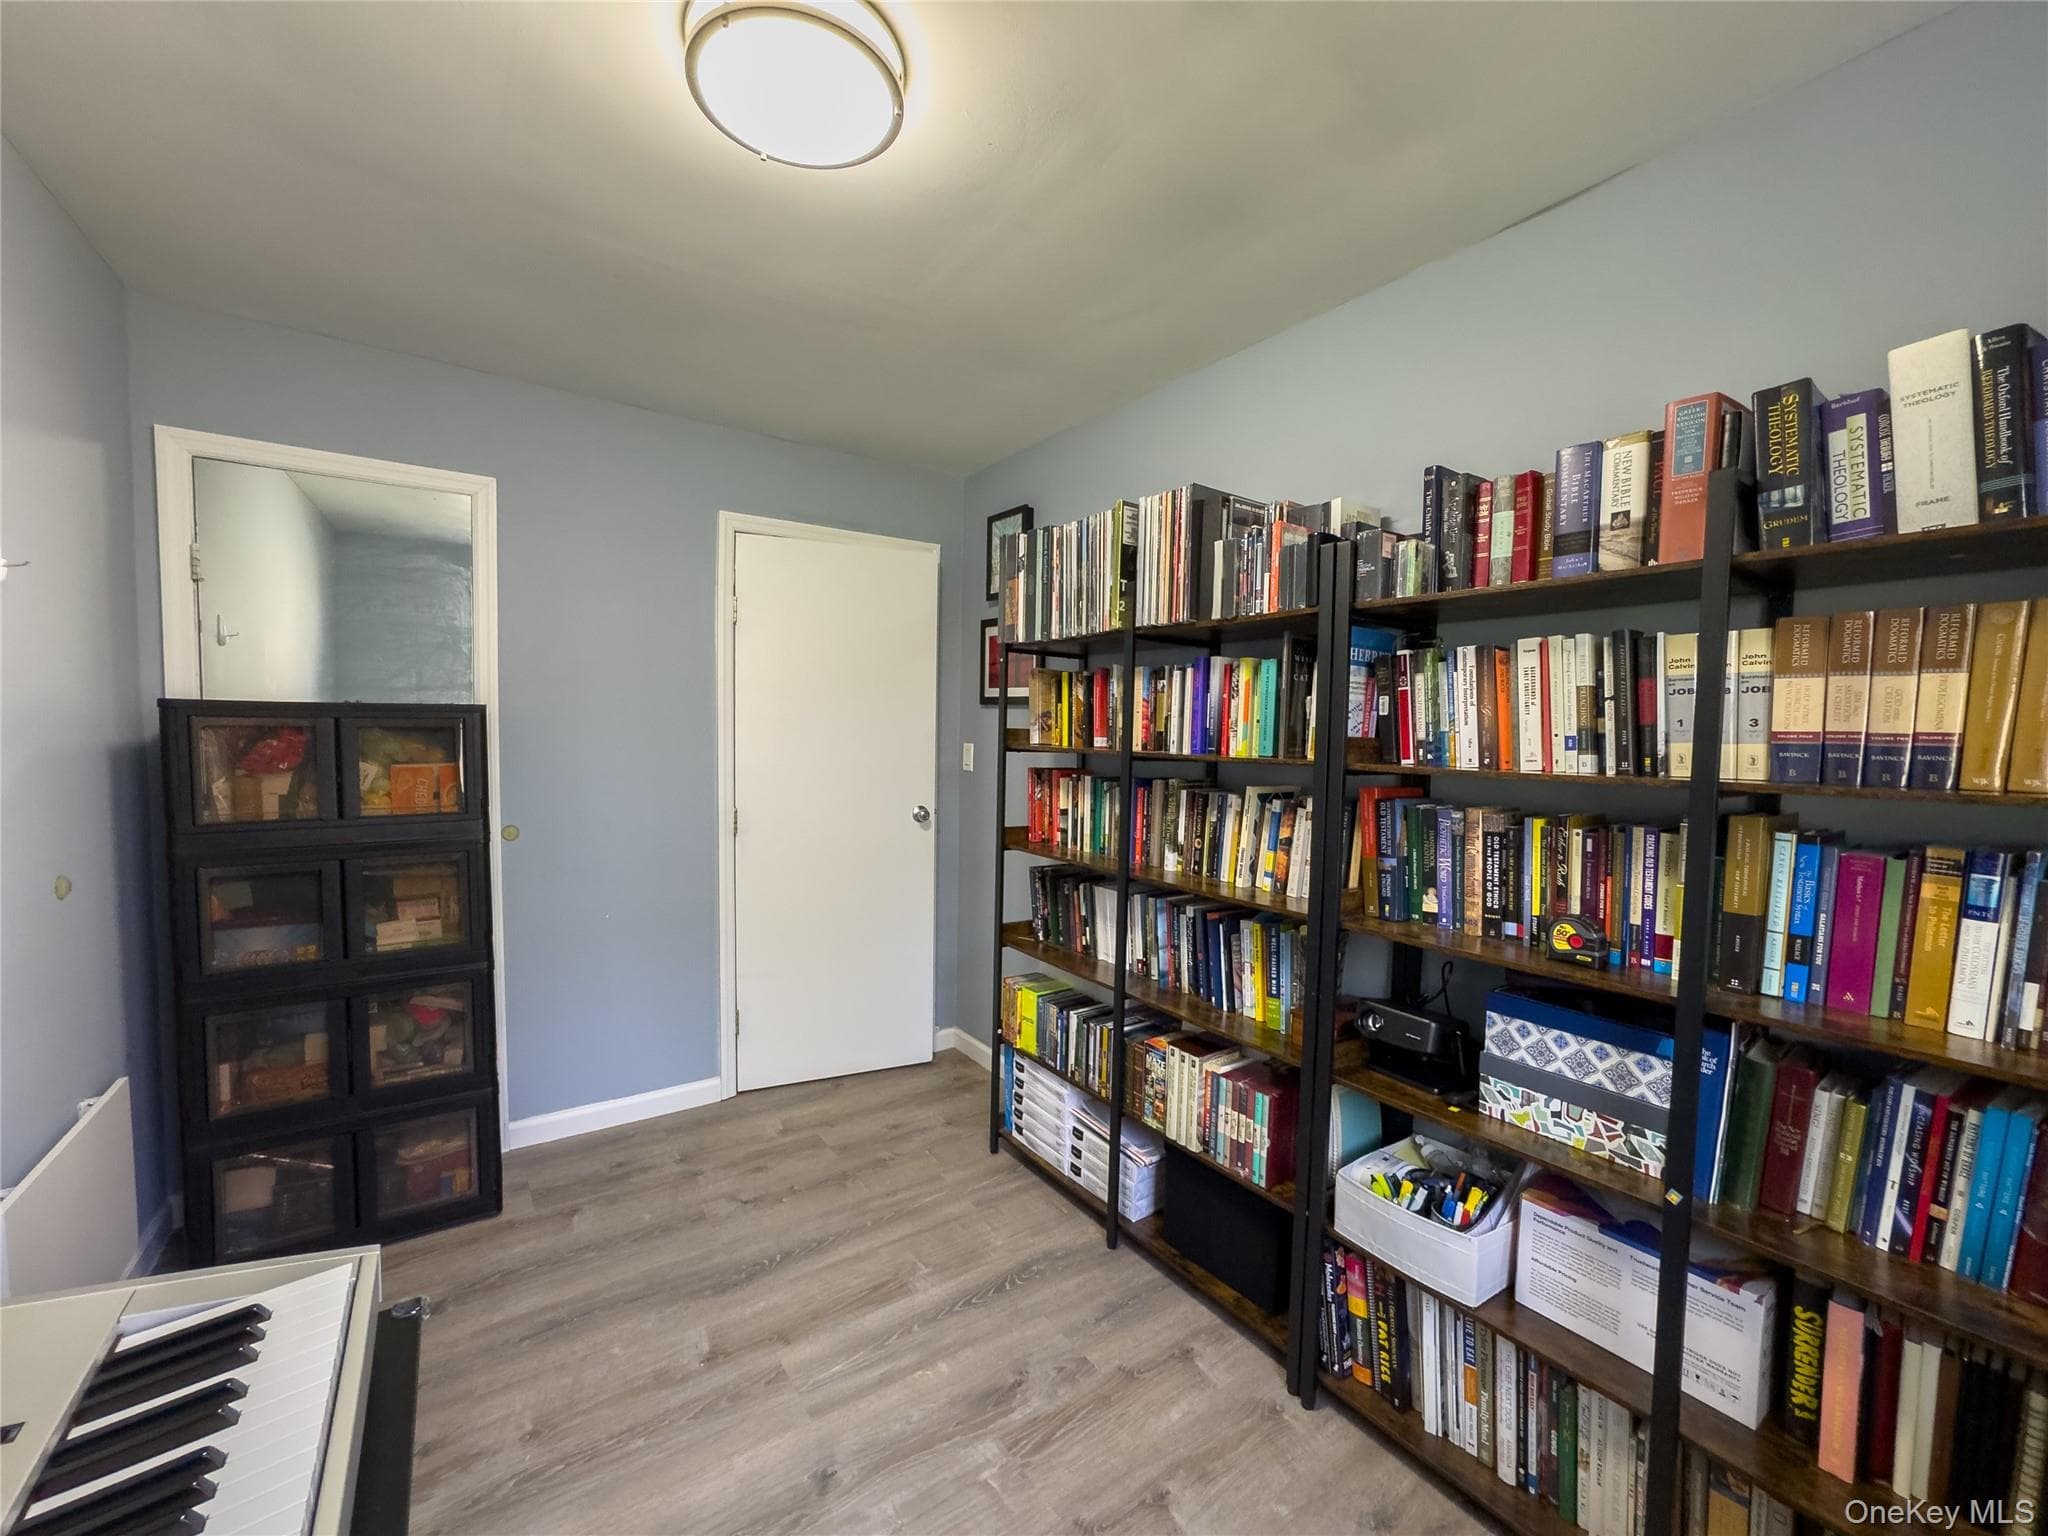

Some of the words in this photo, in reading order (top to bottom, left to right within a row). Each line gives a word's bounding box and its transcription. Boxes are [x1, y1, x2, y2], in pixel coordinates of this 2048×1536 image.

[1997, 365, 2010, 382] The
[1901, 382, 1960, 402] SYSTEMATIC
[1903, 391, 1957, 408] THEOLOGY
[1982, 369, 1994, 420] REFORMED
[1997, 383, 2011, 412] Oxford
[1768, 403, 1783, 475] THEOLOGY
[1783, 392, 1799, 476] SYSTEMATIC
[1983, 420, 1996, 468] THEOLOGY
[1998, 412, 2013, 453] Handbook
[1583, 450, 1592, 467] THE
[1622, 450, 1632, 473] NEW
[1849, 425, 1867, 518] SYSTEMATIC
[1997, 455, 2013, 465] of
[1559, 455, 1571, 526] COMMENTARY
[1571, 473, 1581, 504] BIBLE
[1607, 452, 1621, 508] COMMENTARY
[1620, 474, 1631, 507] BIBLE
[1832, 449, 1848, 521] THEOLOGY
[1915, 497, 1950, 508] FRAME
[1543, 512, 1551, 532] Study
[1763, 514, 1808, 530] GRUDEM
[1543, 534, 1551, 550] Bible
[1791, 624, 1802, 667] DOGMATICS
[1800, 624, 1811, 666] REFORMED
[1842, 619, 1852, 664] DOGMATICS
[1851, 619, 1863, 663] REFORMED
[1887, 618, 1899, 664] DOGMATICS
[1897, 618, 1910, 663] REFORMED
[1935, 613, 1949, 660] DOGMATICS
[1947, 613, 1961, 659] REFORMED
[1668, 687, 1696, 696] JOB
[1741, 685, 1771, 694] JOB
[1579, 686, 1588, 726] PREACHING
[1883, 686, 1893, 724] CREATION
[1934, 675, 1948, 731] PROLEGOMENA
[1677, 719, 1684, 727] 1
[1748, 718, 1760, 728] 3
[1778, 751, 1809, 759] BAVINCK
[1827, 752, 1860, 760] BAVINCK
[1871, 754, 1905, 762] BAVINCK
[1917, 754, 1954, 762] BAVINCK
[1438, 817, 1450, 856] PROPHETIC
[1467, 835, 1479, 847] Ten
[1556, 827, 1568, 853] Esther
[1646, 834, 1655, 857] CRACKING
[1438, 858, 1452, 883] WORD
[1645, 858, 1654, 867] OLD
[1664, 840, 1673, 877] Ecclesiastes
[1778, 845, 1787, 874] CANON
[1799, 855, 1807, 869] New
[1466, 848, 1480, 901] Commandments
[1486, 882, 1492, 890] OF
[1556, 863, 1567, 887] Ruth
[1645, 868, 1653, 894] TESTAMENT
[1796, 871, 1806, 903] Testament
[1644, 895, 1653, 910] CODES
[1772, 878, 1785, 927] REVISITED
[1804, 880, 1816, 904] Basics
[1793, 904, 1803, 924] Syntax
[1928, 906, 1937, 915] to
[1941, 907, 1952, 922] The
[1817, 913, 1826, 942] GALATIANS
[1924, 916, 1937, 951] Philemon
[1938, 923, 1950, 947] Letter
[1794, 938, 1802, 960] WALLACE
[1815, 954, 1823, 966] YOU
[1816, 942, 1825, 953] FOR
[1957, 947, 1969, 985] PHILEMON
[1968, 946, 1982, 990] COLOSSIANS
[1811, 1104, 1822, 1128] SING!
[1911, 1105, 1927, 1148] UNCEASING
[1950, 1120, 1959, 1130] THE
[1945, 1131, 1957, 1161] DANGEROUS
[1906, 1151, 1922, 1186] WORSHIP
[1937, 1179, 1949, 1203] WORSHIP
[1902, 1199, 1910, 1214] BEST
[1533, 1217, 1566, 1235] Performance
[1533, 1211, 1564, 1229] Dependable
[1564, 1226, 1585, 1239] Product
[1586, 1235, 1605, 1249] Quality
[1950, 1208, 1961, 1236] COSPER
[1531, 1257, 1557, 1273] Affordable
[1558, 1270, 1577, 1283] Pricing
[1700, 1286, 1725, 1302] Service
[1726, 1297, 1746, 1312] Team
[1465, 1317, 1475, 1334] LIVE
[1479, 1328, 1489, 1349] Tyler
[1465, 1337, 1475, 1345] TO
[1465, 1347, 1475, 1363] EAT
[1789, 1305, 1823, 1411] SURRENDER
[1480, 1350, 1489, 1390] Florence
[1479, 1390, 1489, 1422] Family
[1480, 1422, 1490, 1444] Meal
